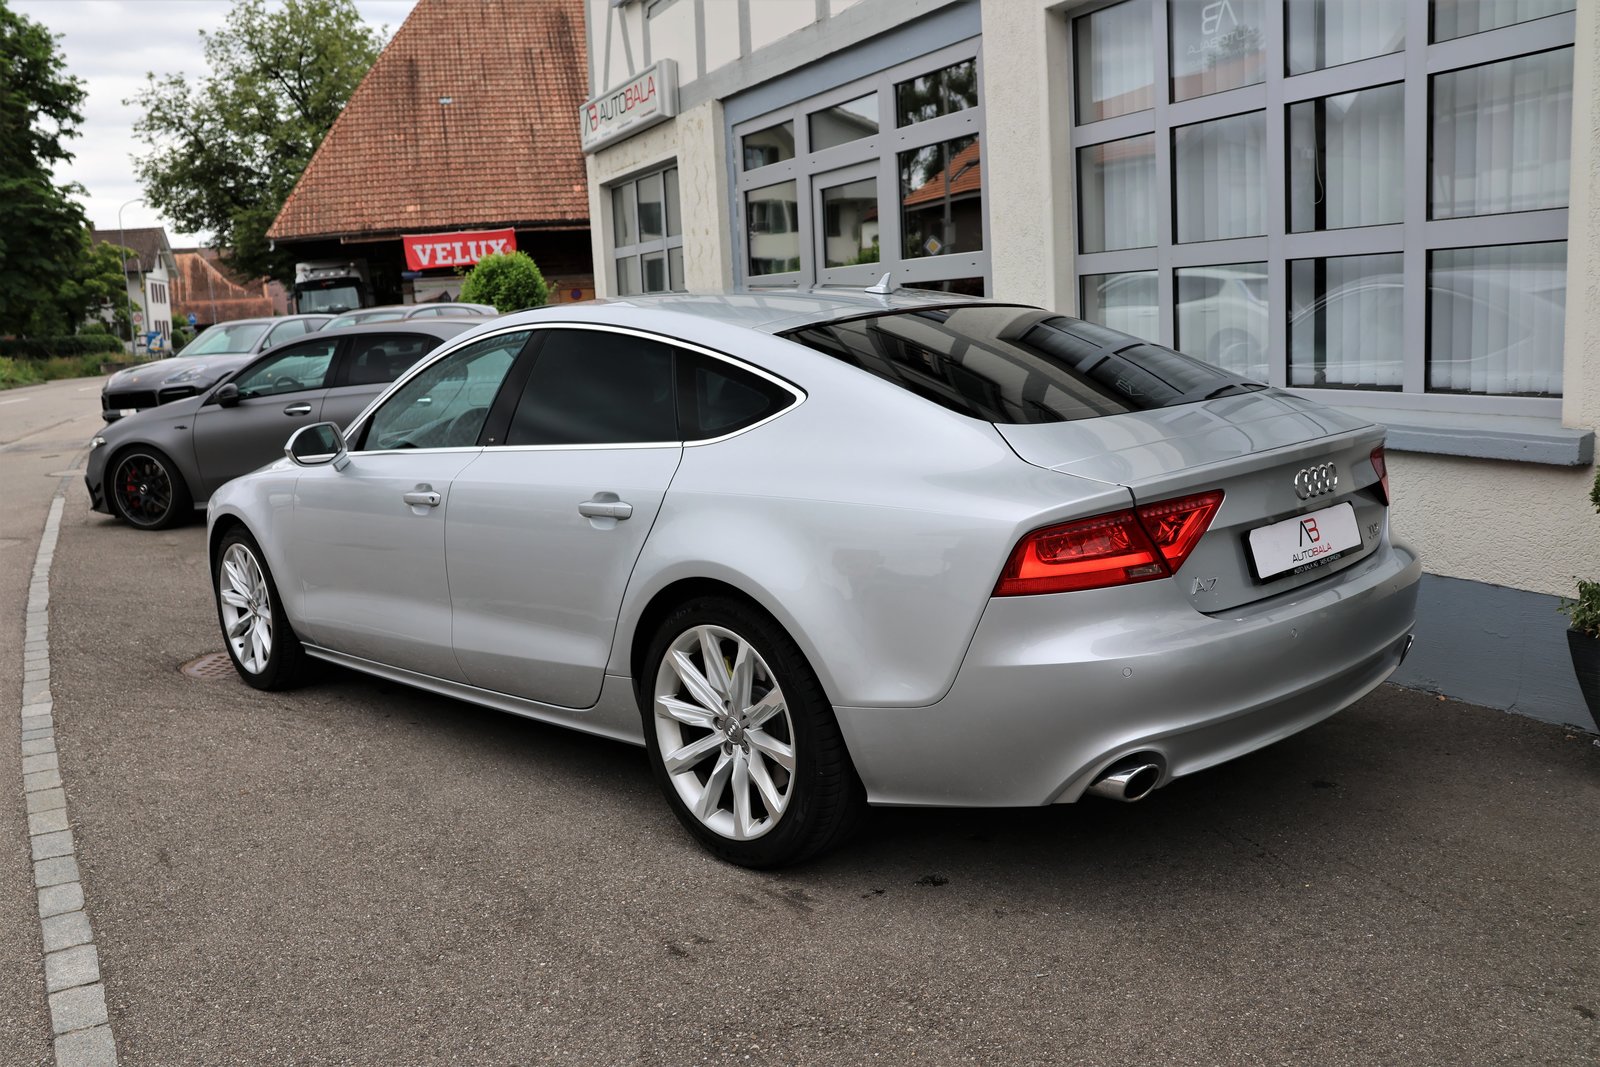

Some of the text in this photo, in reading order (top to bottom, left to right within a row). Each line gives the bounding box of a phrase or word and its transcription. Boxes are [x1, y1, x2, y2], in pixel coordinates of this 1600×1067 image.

[600, 75, 656, 124] AUTOBALA
[412, 238, 507, 266] VELUX
[1292, 542, 1333, 564] AUTOBALA
[1191, 576, 1218, 595] A7
